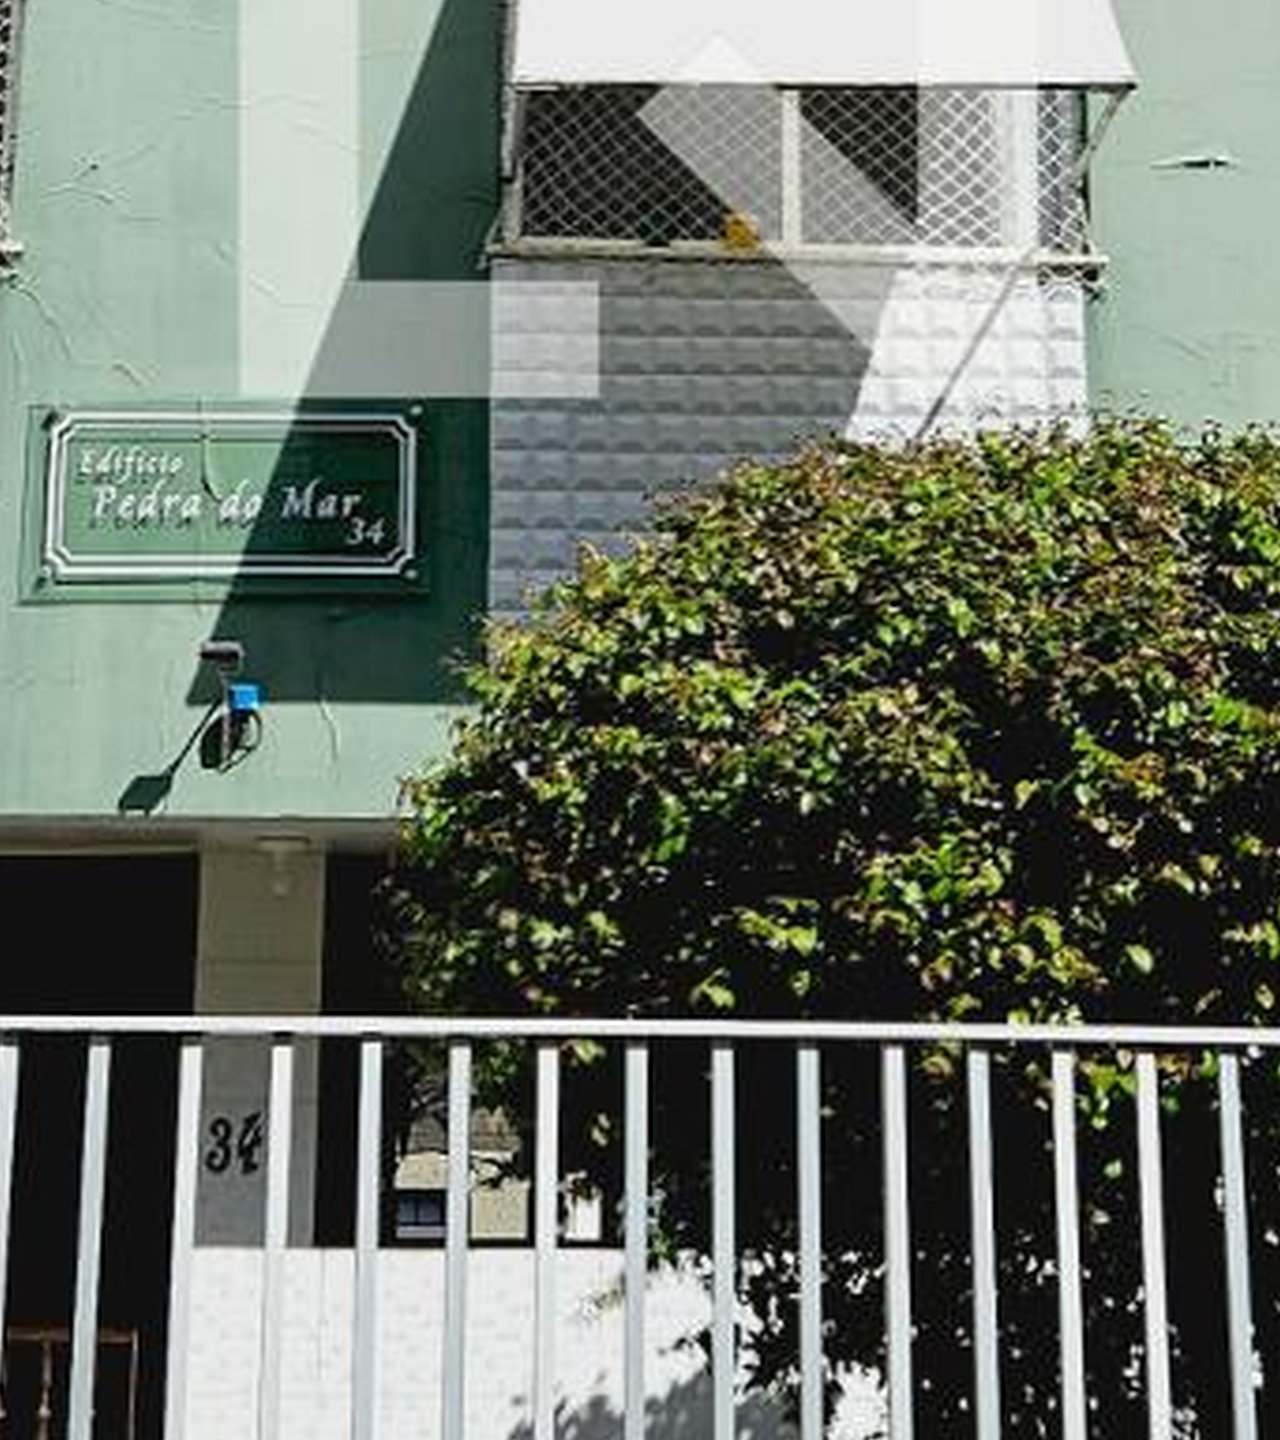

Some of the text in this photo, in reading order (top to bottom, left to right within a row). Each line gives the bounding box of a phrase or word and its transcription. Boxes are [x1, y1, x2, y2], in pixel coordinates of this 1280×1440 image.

[93, 479, 202, 519] Pedra
[281, 476, 362, 519] Mar
[346, 517, 386, 545] 34
